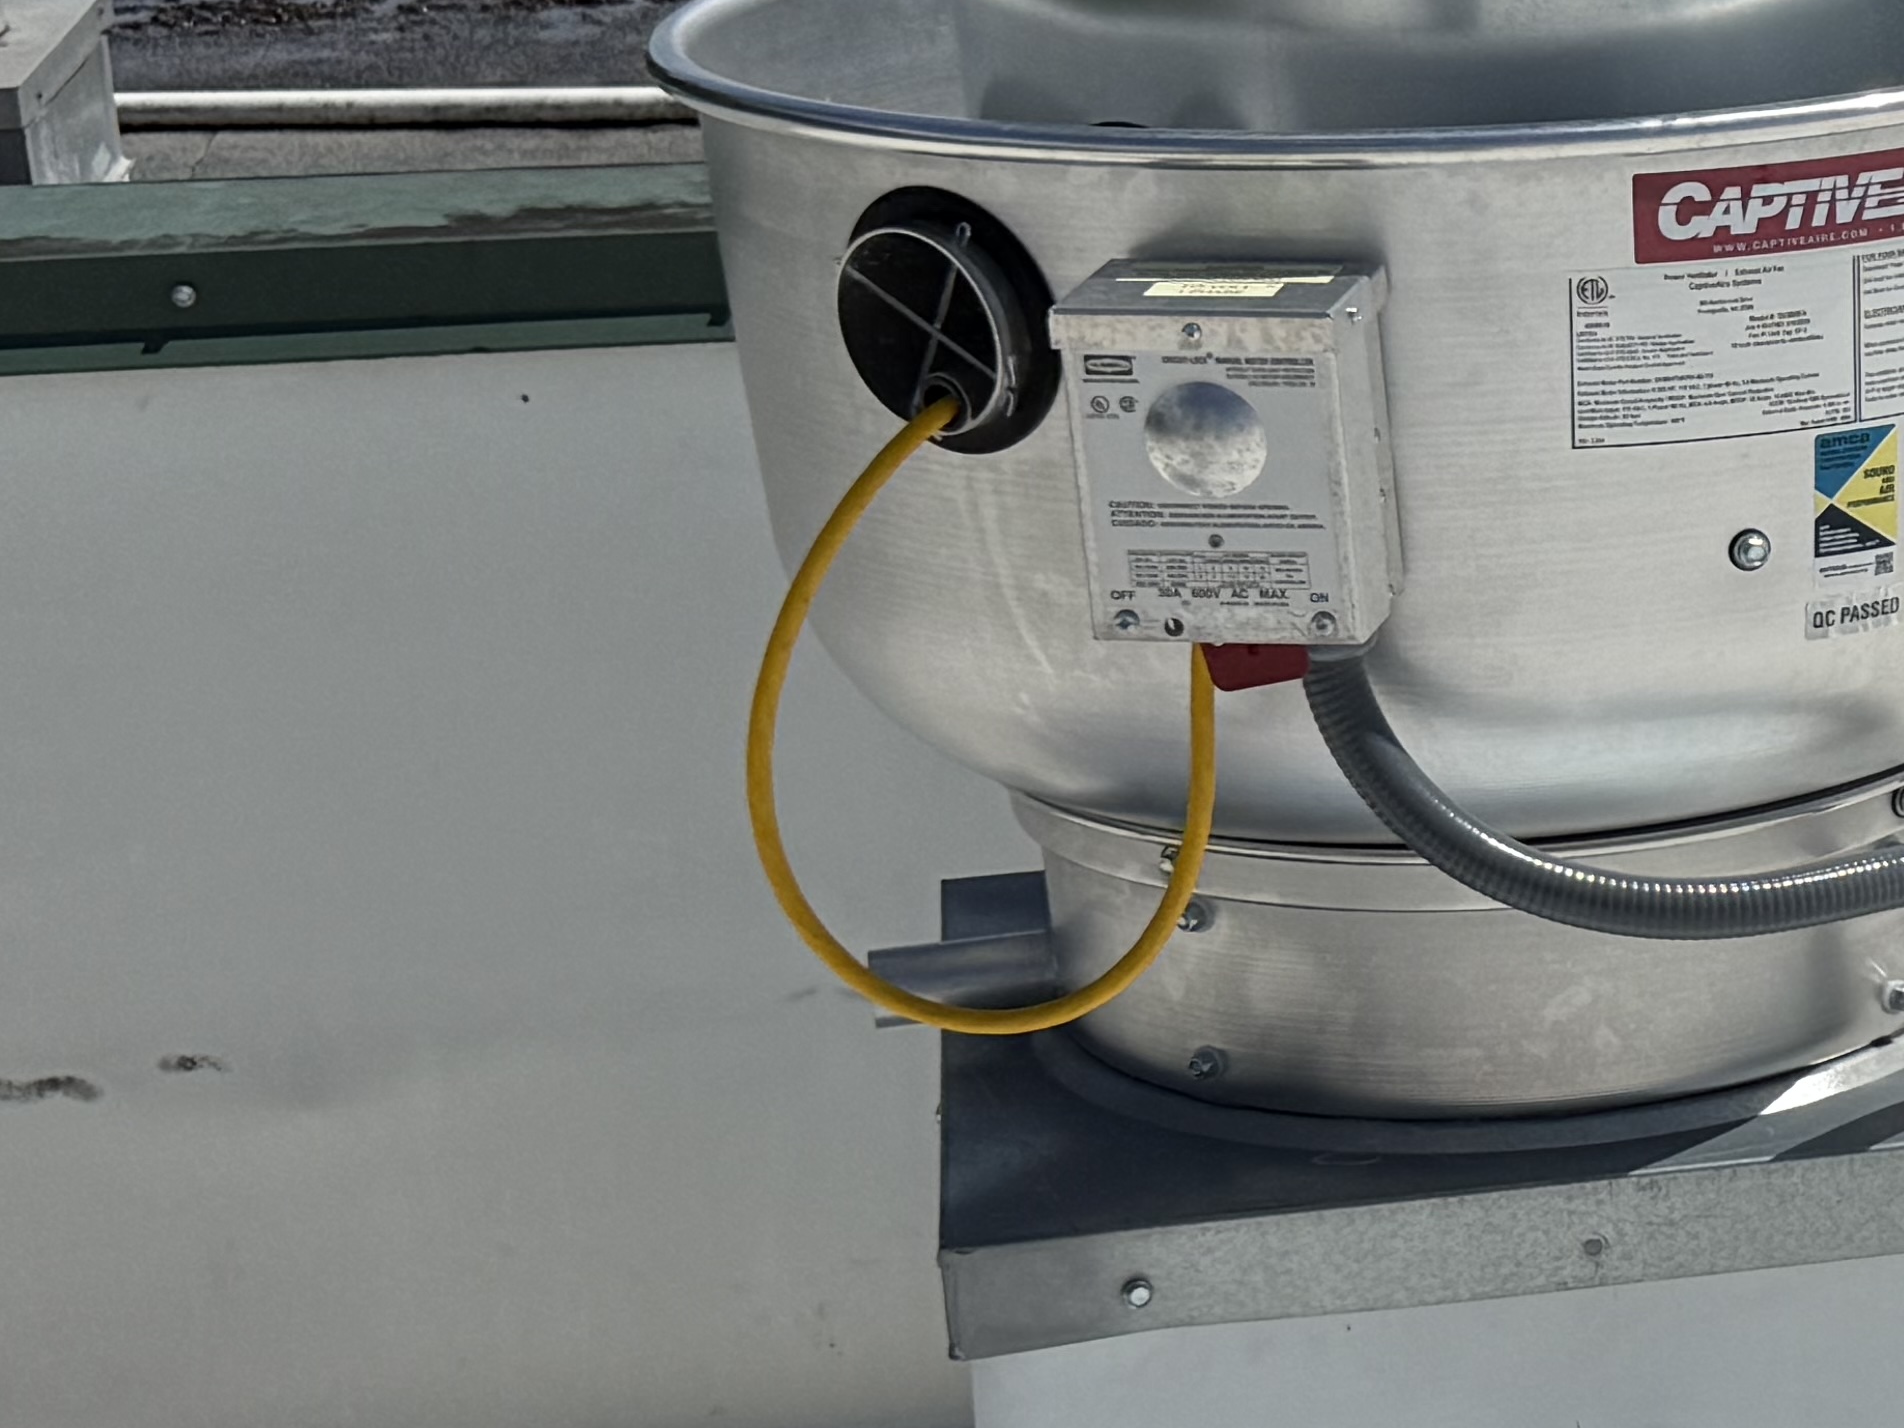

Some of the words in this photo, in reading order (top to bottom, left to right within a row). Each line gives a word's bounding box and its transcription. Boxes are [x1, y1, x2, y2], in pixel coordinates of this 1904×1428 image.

[1110, 590, 1136, 601] OFF
[1813, 609, 1836, 628] QC
[1840, 596, 1900, 624] PASSED
